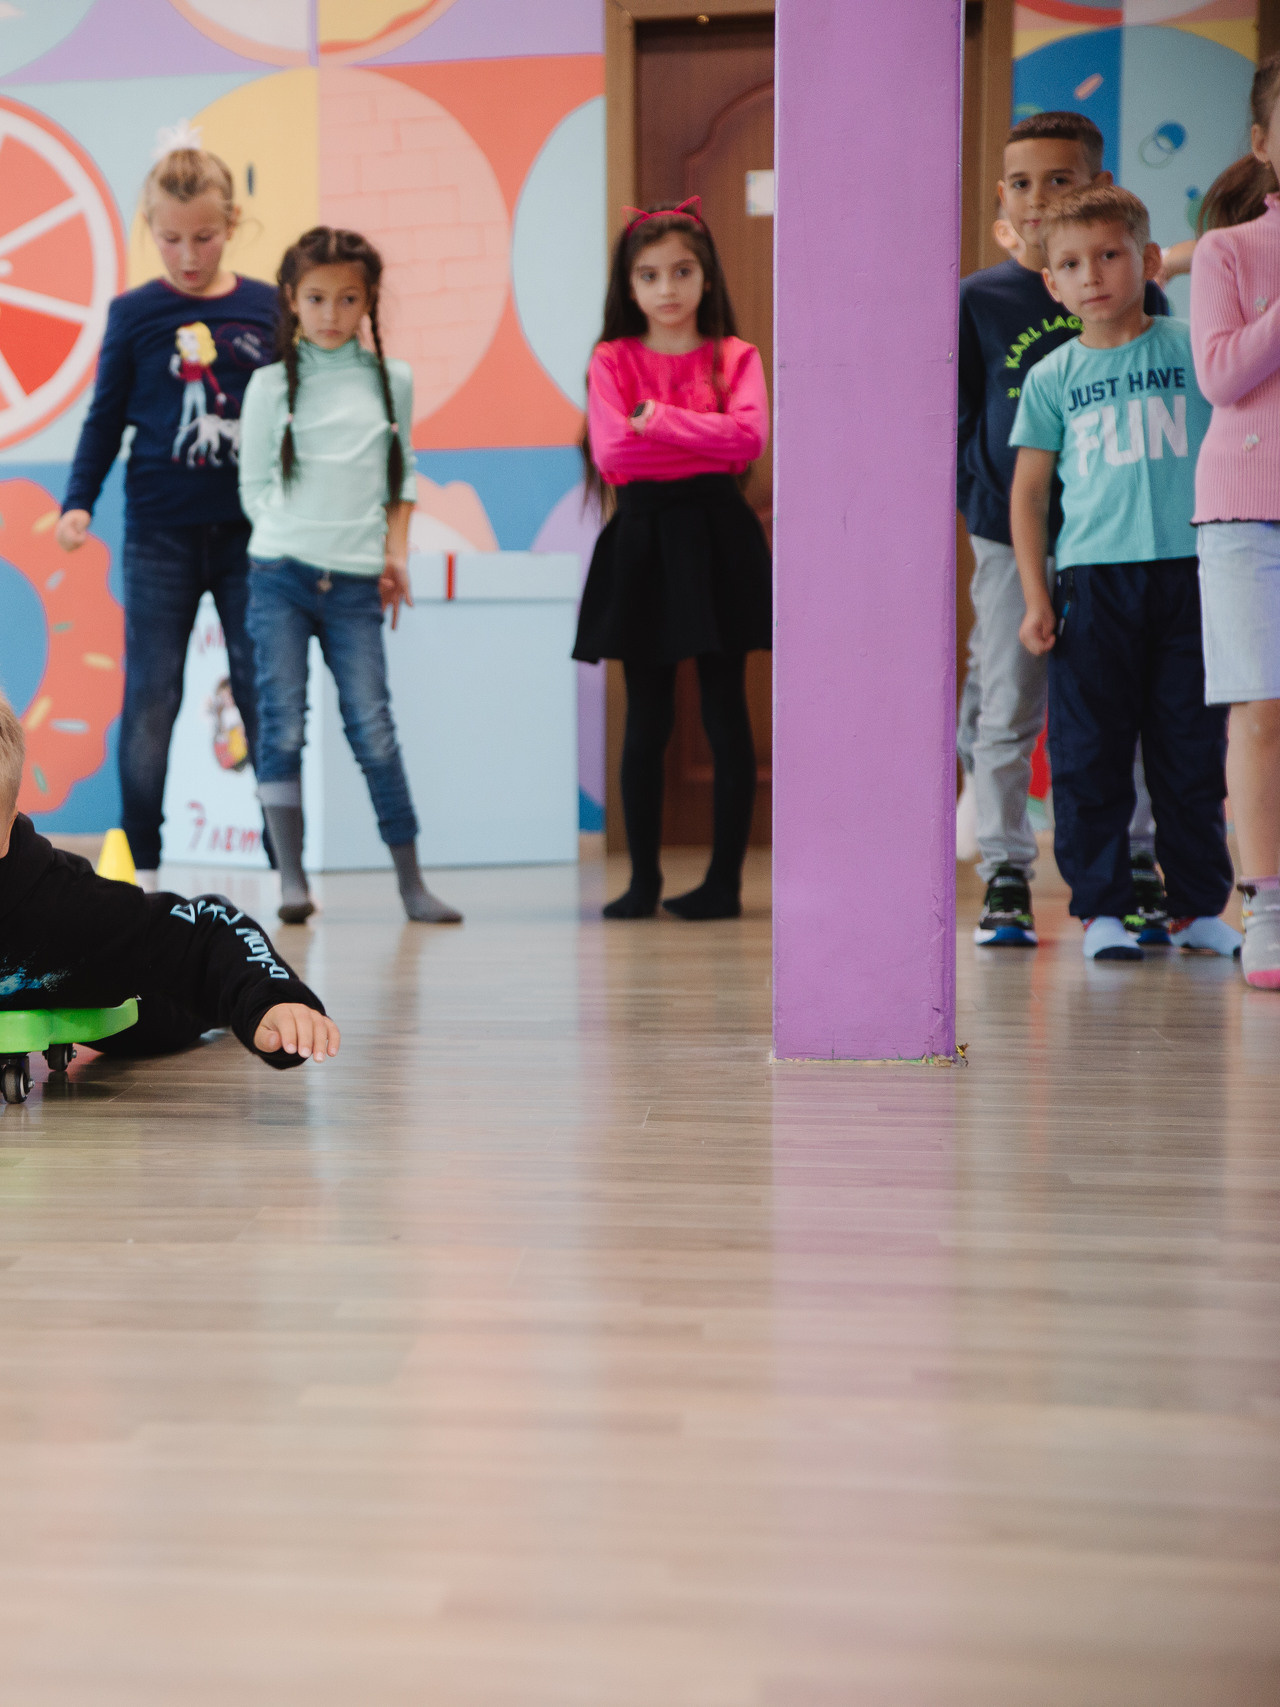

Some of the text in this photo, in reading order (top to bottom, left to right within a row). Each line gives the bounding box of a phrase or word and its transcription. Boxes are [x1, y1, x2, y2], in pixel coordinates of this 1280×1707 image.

[1004, 314, 1084, 369] KARL LAG
[1068, 366, 1186, 412] JUST HAVE
[1070, 394, 1189, 477] FUN
